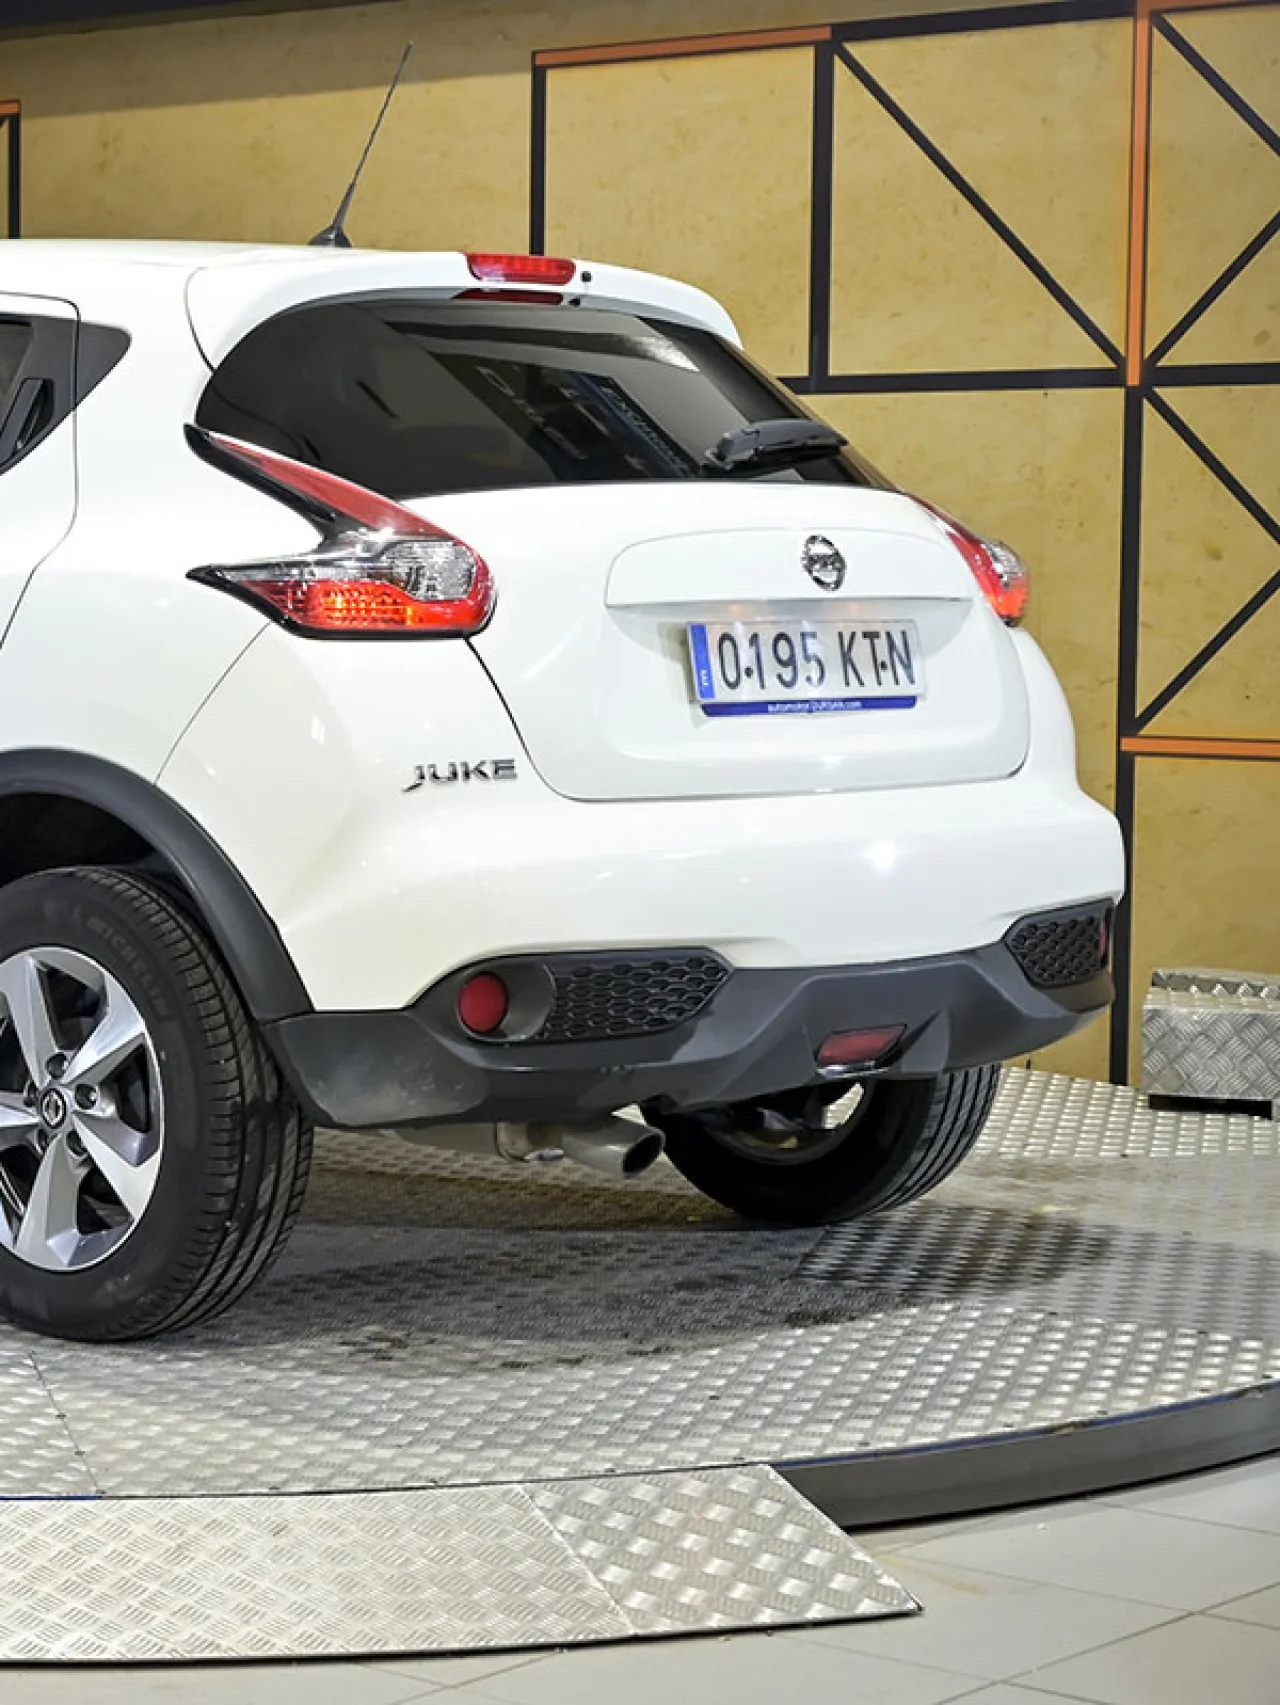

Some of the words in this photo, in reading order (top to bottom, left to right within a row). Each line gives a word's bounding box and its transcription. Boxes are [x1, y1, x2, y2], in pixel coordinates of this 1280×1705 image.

[718, 630, 826, 690] 0195
[837, 629, 916, 688] KTN
[401, 758, 518, 793] JUKE
